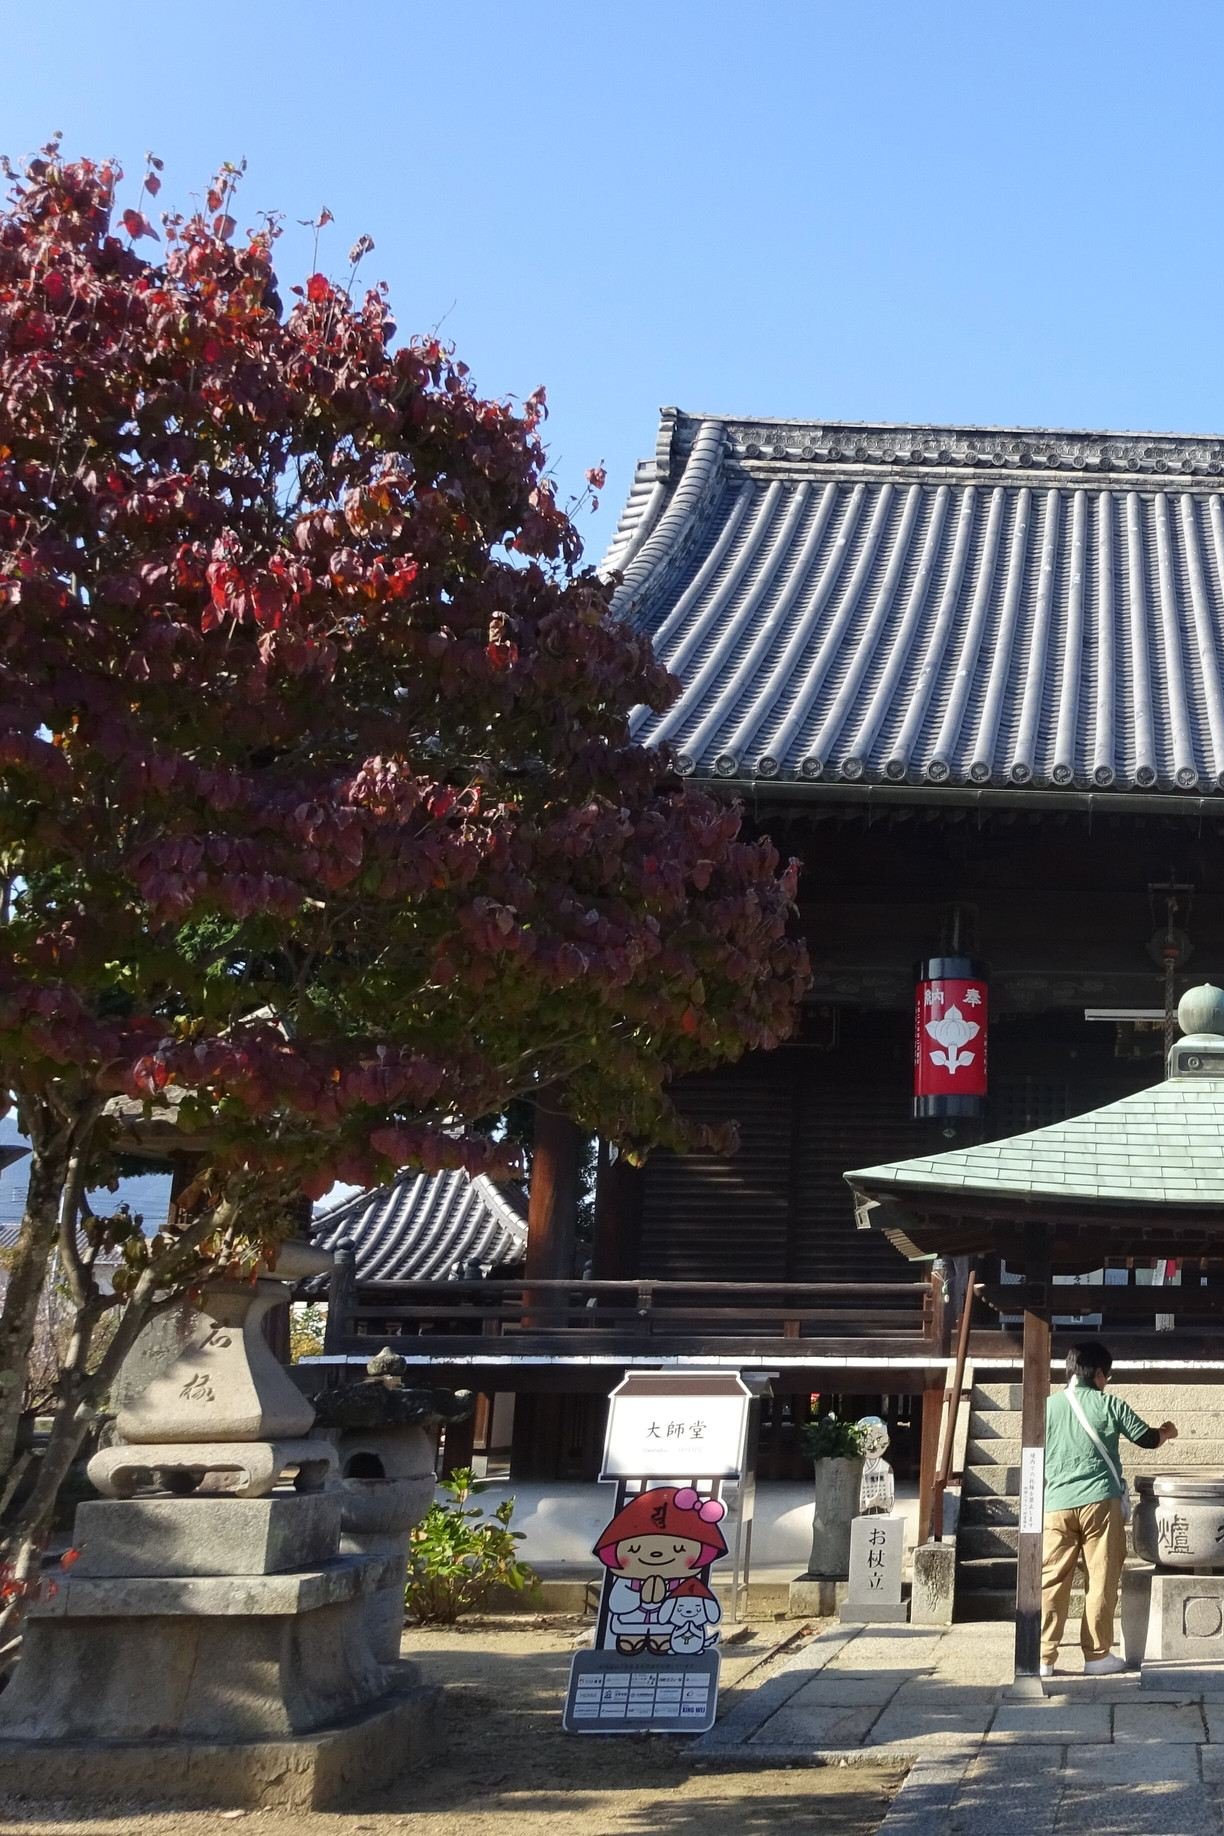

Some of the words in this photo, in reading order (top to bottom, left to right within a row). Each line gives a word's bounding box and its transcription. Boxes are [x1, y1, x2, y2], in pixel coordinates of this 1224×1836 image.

[646, 1419, 707, 1440] 大師堂
[867, 1527, 887, 1591] お杖立
